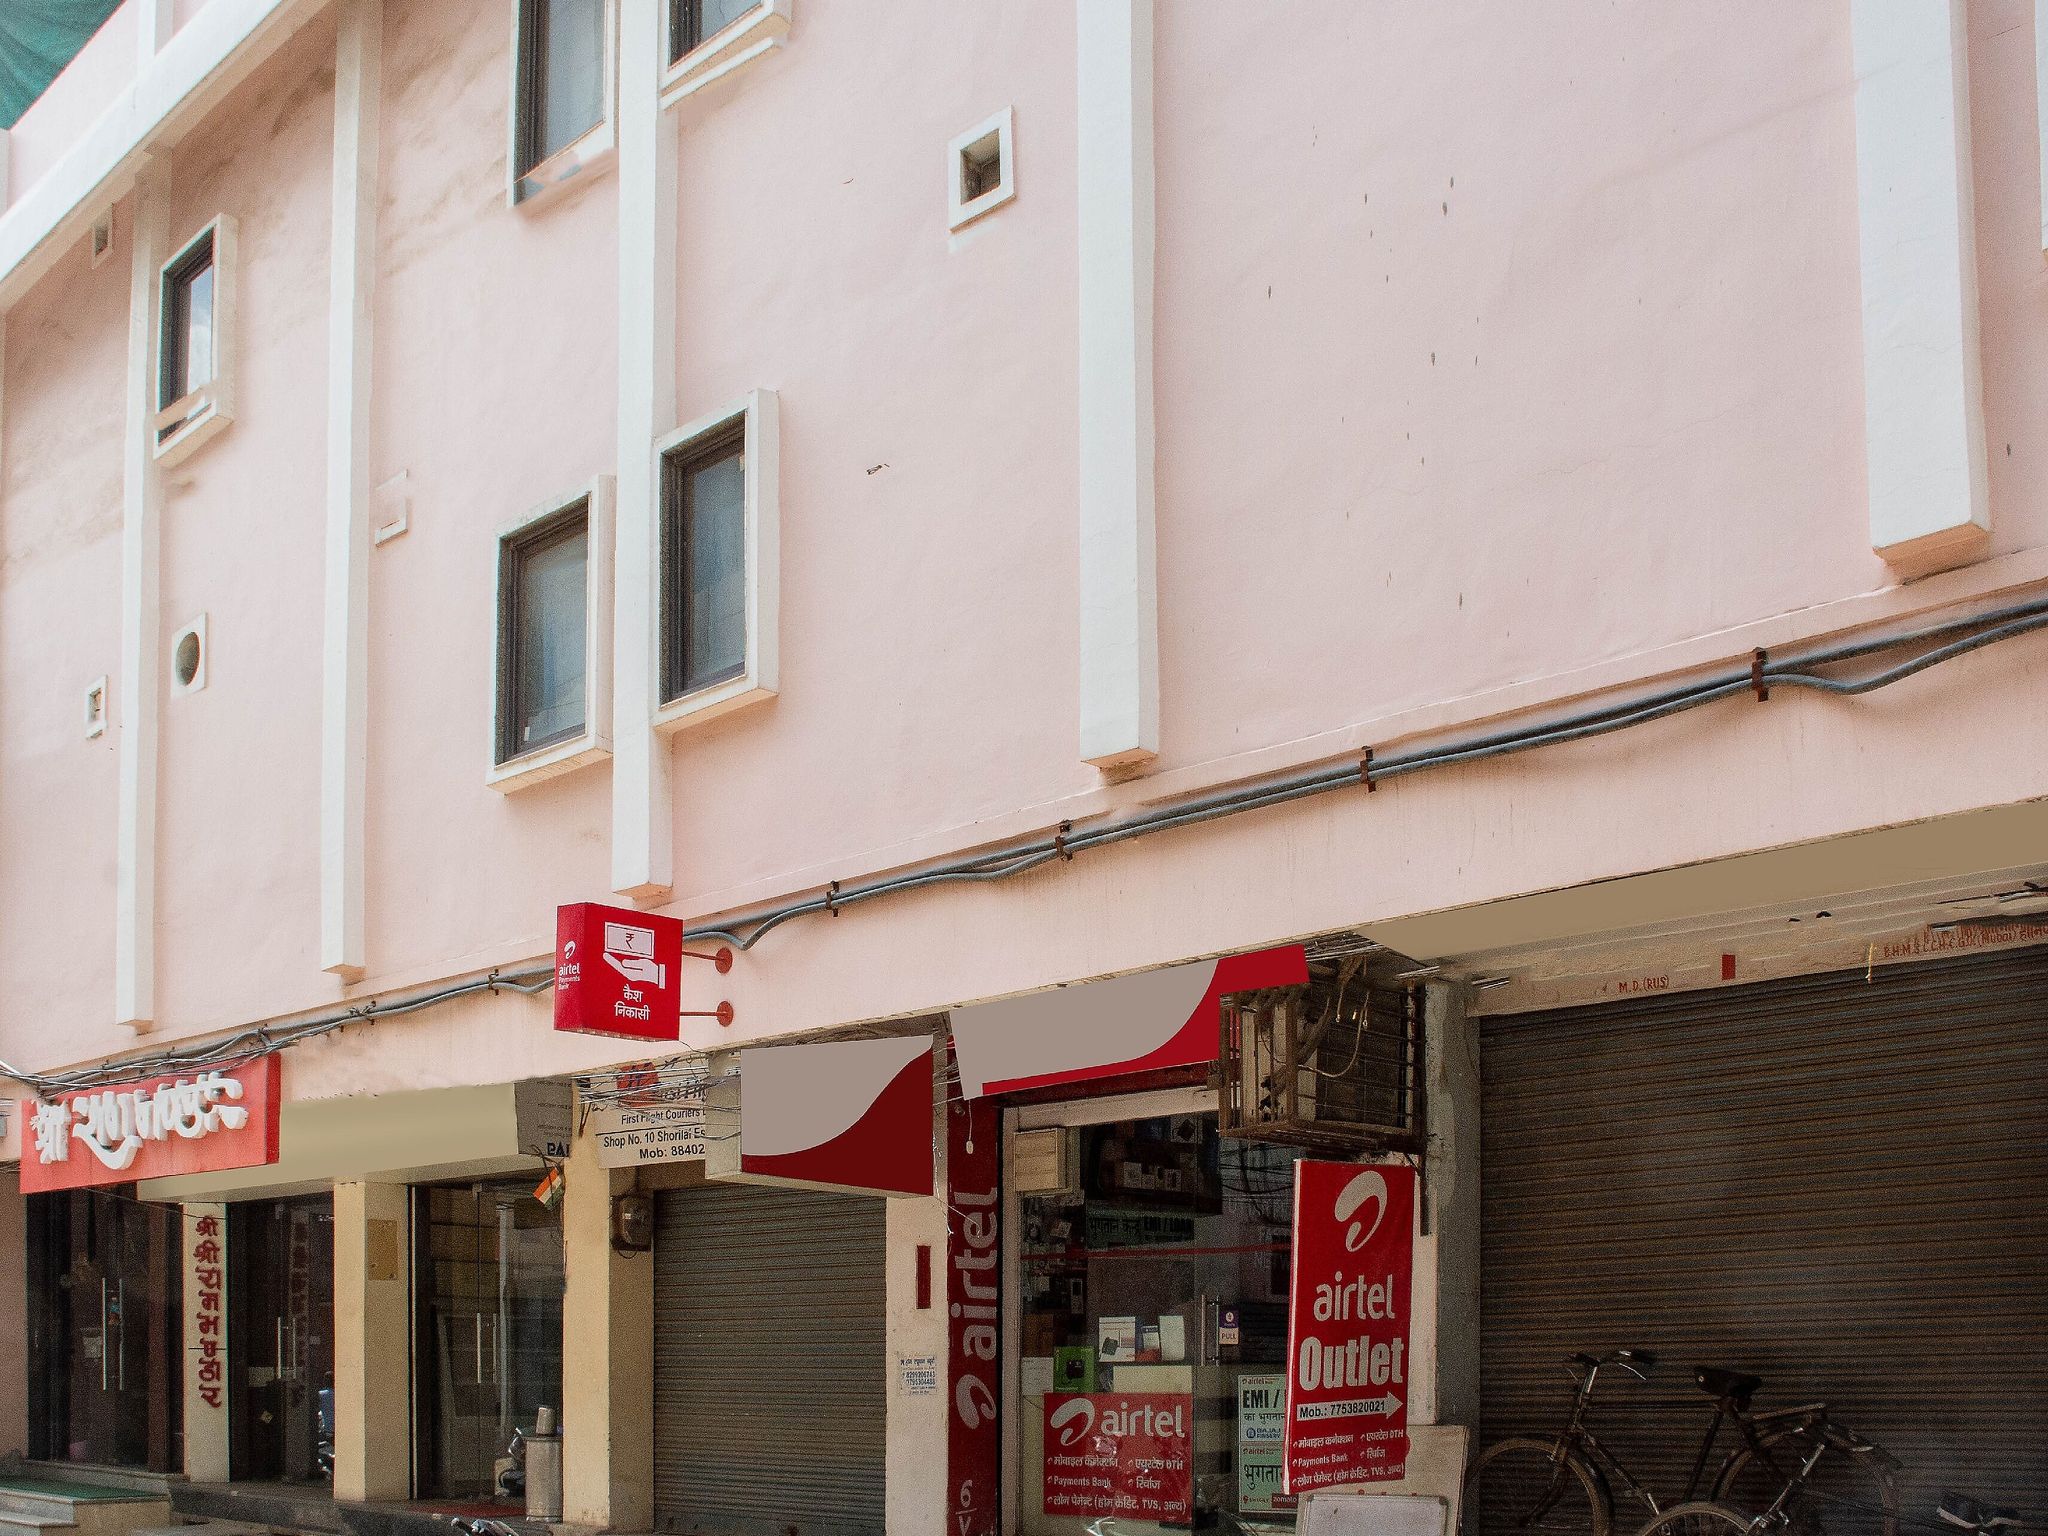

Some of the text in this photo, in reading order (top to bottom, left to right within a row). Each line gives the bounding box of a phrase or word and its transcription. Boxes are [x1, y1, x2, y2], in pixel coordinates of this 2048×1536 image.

[559, 962, 581, 976] airtel
[623, 983, 644, 1003] कैश
[614, 1000, 651, 1021] निकासी
[621, 1112, 639, 1125] First
[665, 1108, 700, 1120] Couriers
[604, 1132, 626, 1149] Shop
[627, 1129, 643, 1147] No.
[644, 1131, 655, 1144] 10
[639, 1143, 706, 1159] Mob: 88402
[955, 1187, 998, 1361] airtel
[1313, 1270, 1395, 1322] airtel
[1299, 1335, 1405, 1391] Outlet
[1242, 1389, 1269, 1409] EMI
[1330, 1400, 1386, 1416] 7753820021
[1101, 1401, 1186, 1438] airtel
[1298, 1453, 1349, 1468] Payments Bank
[1053, 1475, 1112, 1489] Payments Bank
[1244, 1464, 1283, 1490] भुगता
